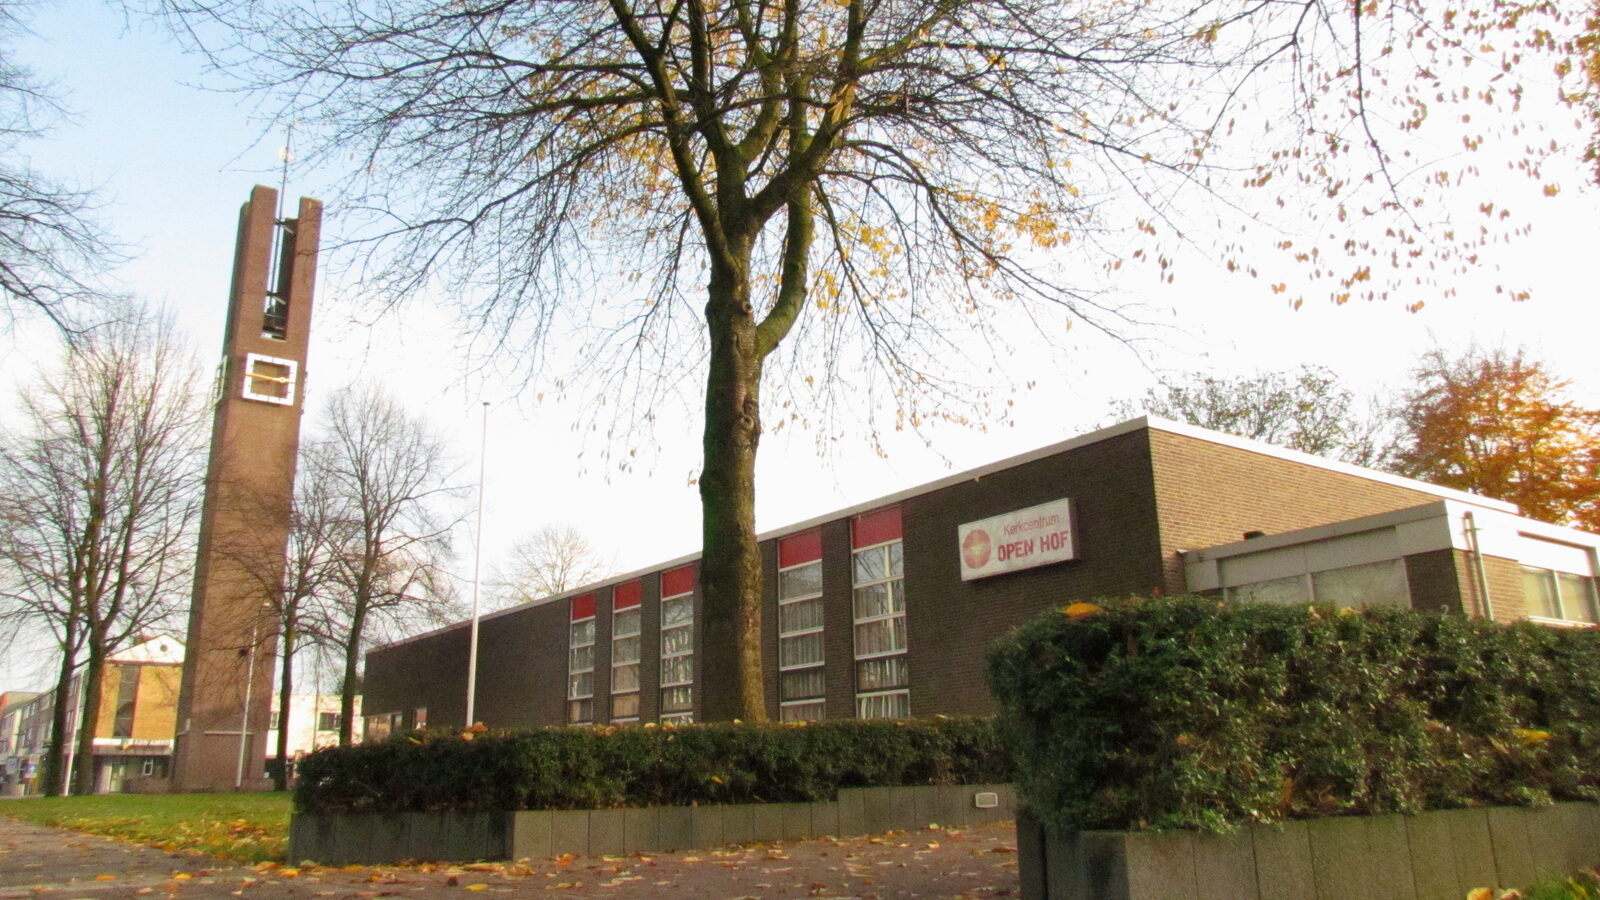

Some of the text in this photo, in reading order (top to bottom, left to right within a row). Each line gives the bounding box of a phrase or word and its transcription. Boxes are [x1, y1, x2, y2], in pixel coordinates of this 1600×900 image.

[1003, 514, 1060, 536] Kerkcentrum
[997, 530, 1069, 561] OPEN HOF
